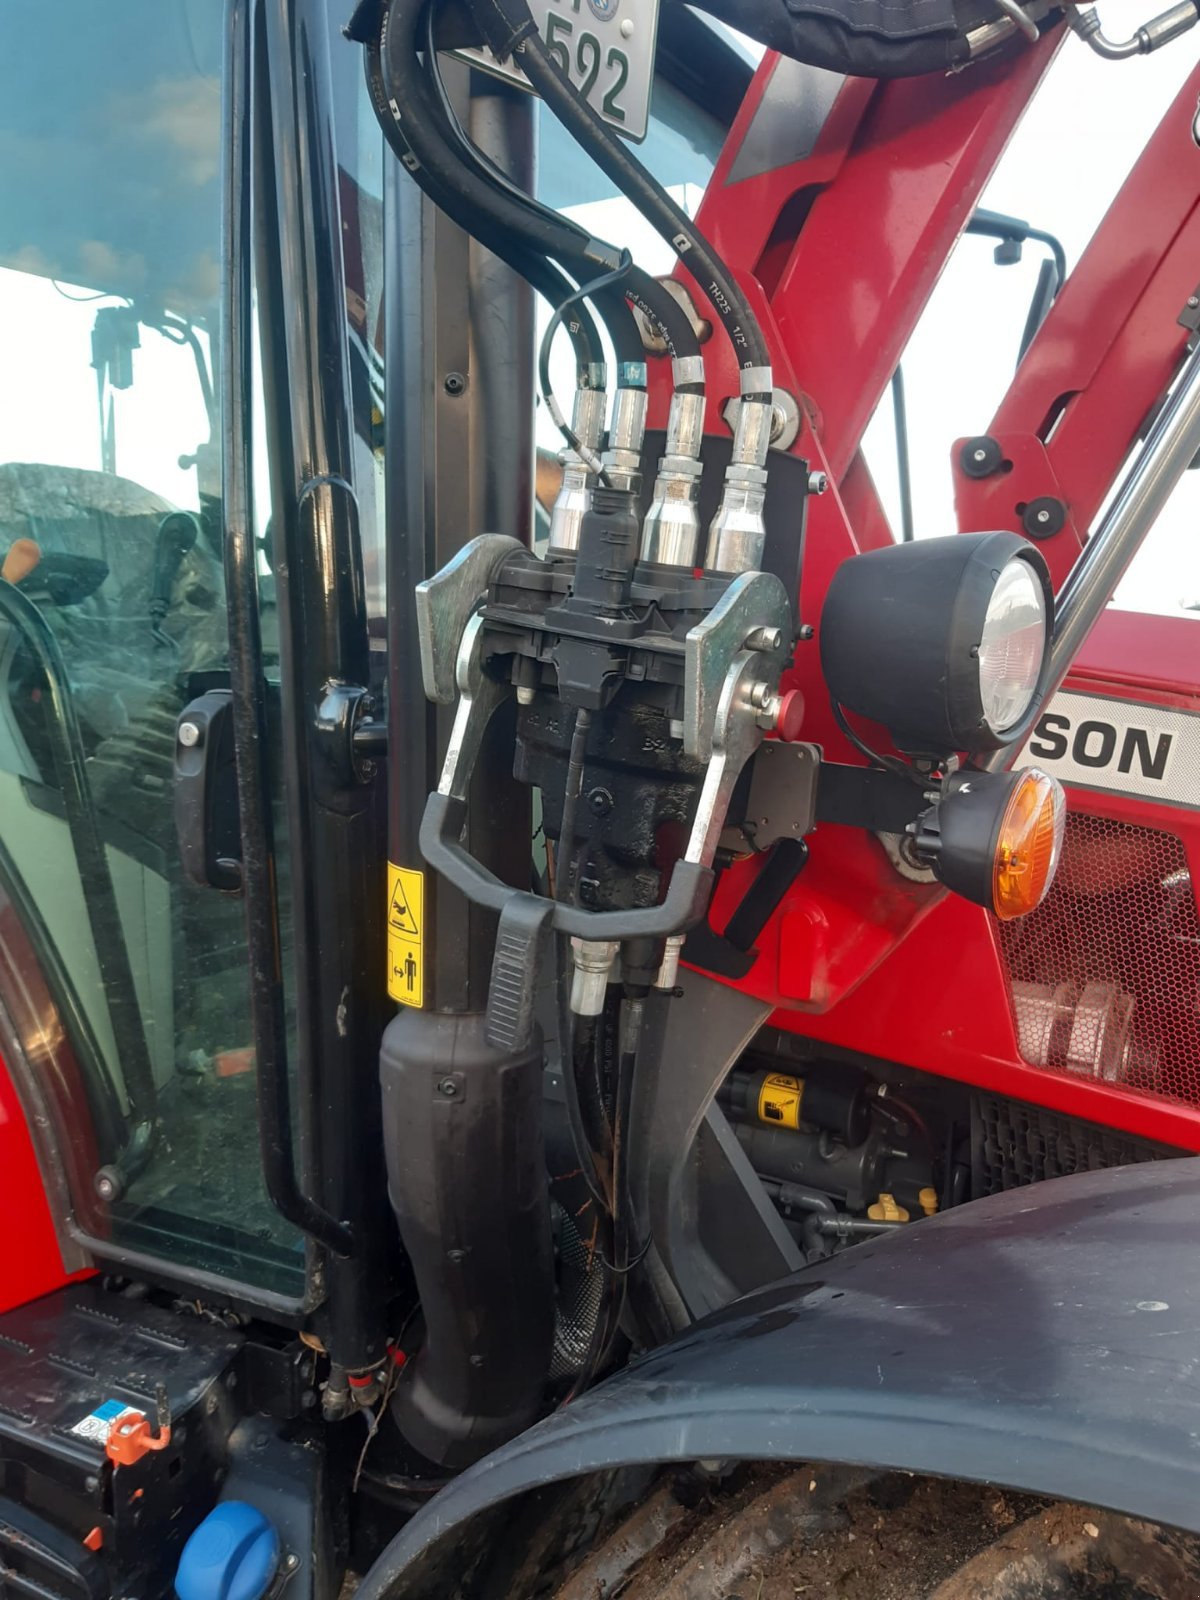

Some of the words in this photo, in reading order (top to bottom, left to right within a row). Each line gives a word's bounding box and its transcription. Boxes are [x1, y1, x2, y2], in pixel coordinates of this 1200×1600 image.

[546, 11, 629, 122] 592
[708, 281, 732, 315] TH225
[1029, 712, 1174, 781] SON
